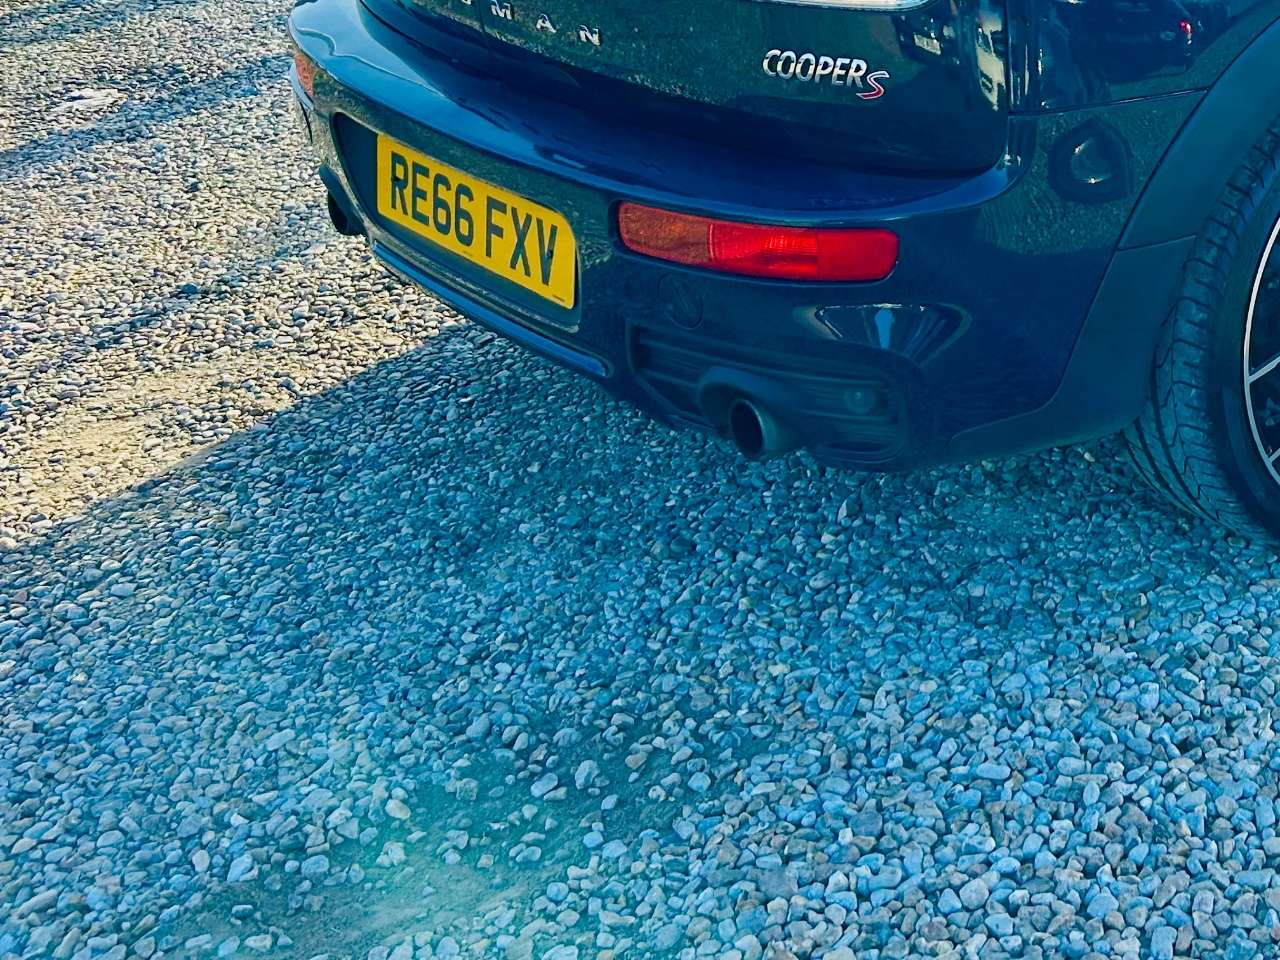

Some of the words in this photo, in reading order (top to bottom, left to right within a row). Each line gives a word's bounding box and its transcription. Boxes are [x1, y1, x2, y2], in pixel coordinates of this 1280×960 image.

[762, 48, 868, 89] COOPER
[856, 70, 890, 100] S
[390, 150, 475, 248] RE66
[485, 194, 559, 287] FXV
